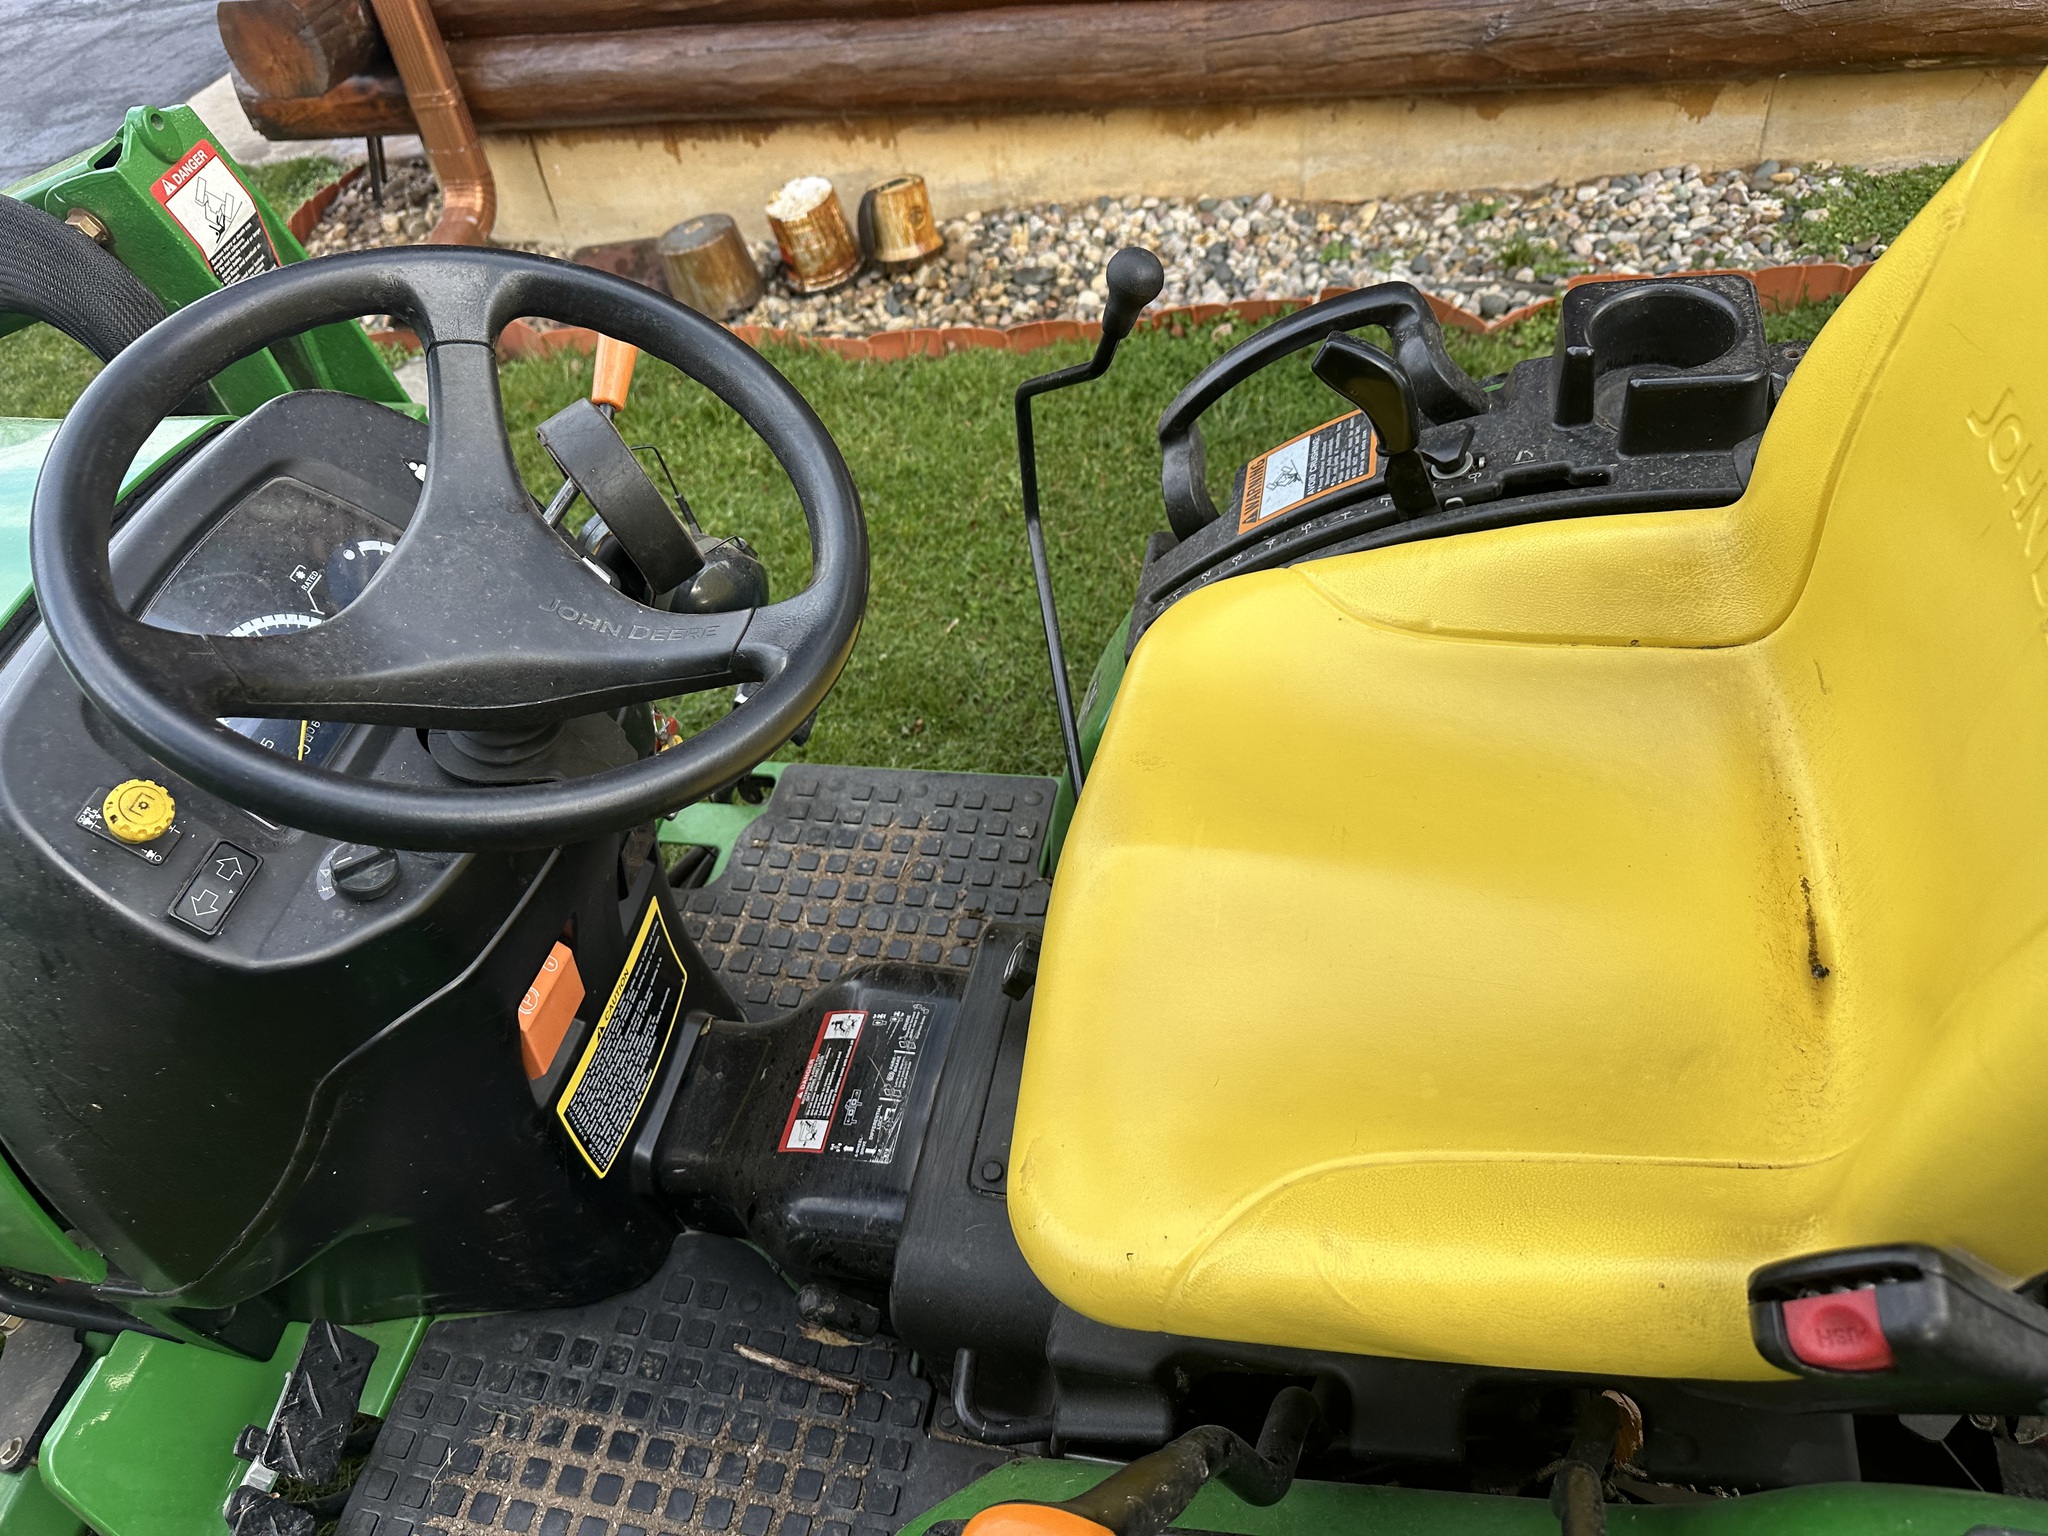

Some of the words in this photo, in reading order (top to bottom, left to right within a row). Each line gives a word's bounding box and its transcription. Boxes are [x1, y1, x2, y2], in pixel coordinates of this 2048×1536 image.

[171, 149, 209, 186] DANGER
[1243, 456, 1265, 517] WARNING
[1307, 474, 1316, 495] AVOID
[301, 570, 319, 591] RATED
[538, 598, 621, 639] JOHN
[627, 624, 721, 643] DEERE
[260, 737, 275, 750] 5
[604, 968, 629, 1022] CAUTION
[800, 1059, 815, 1090] DANGER
